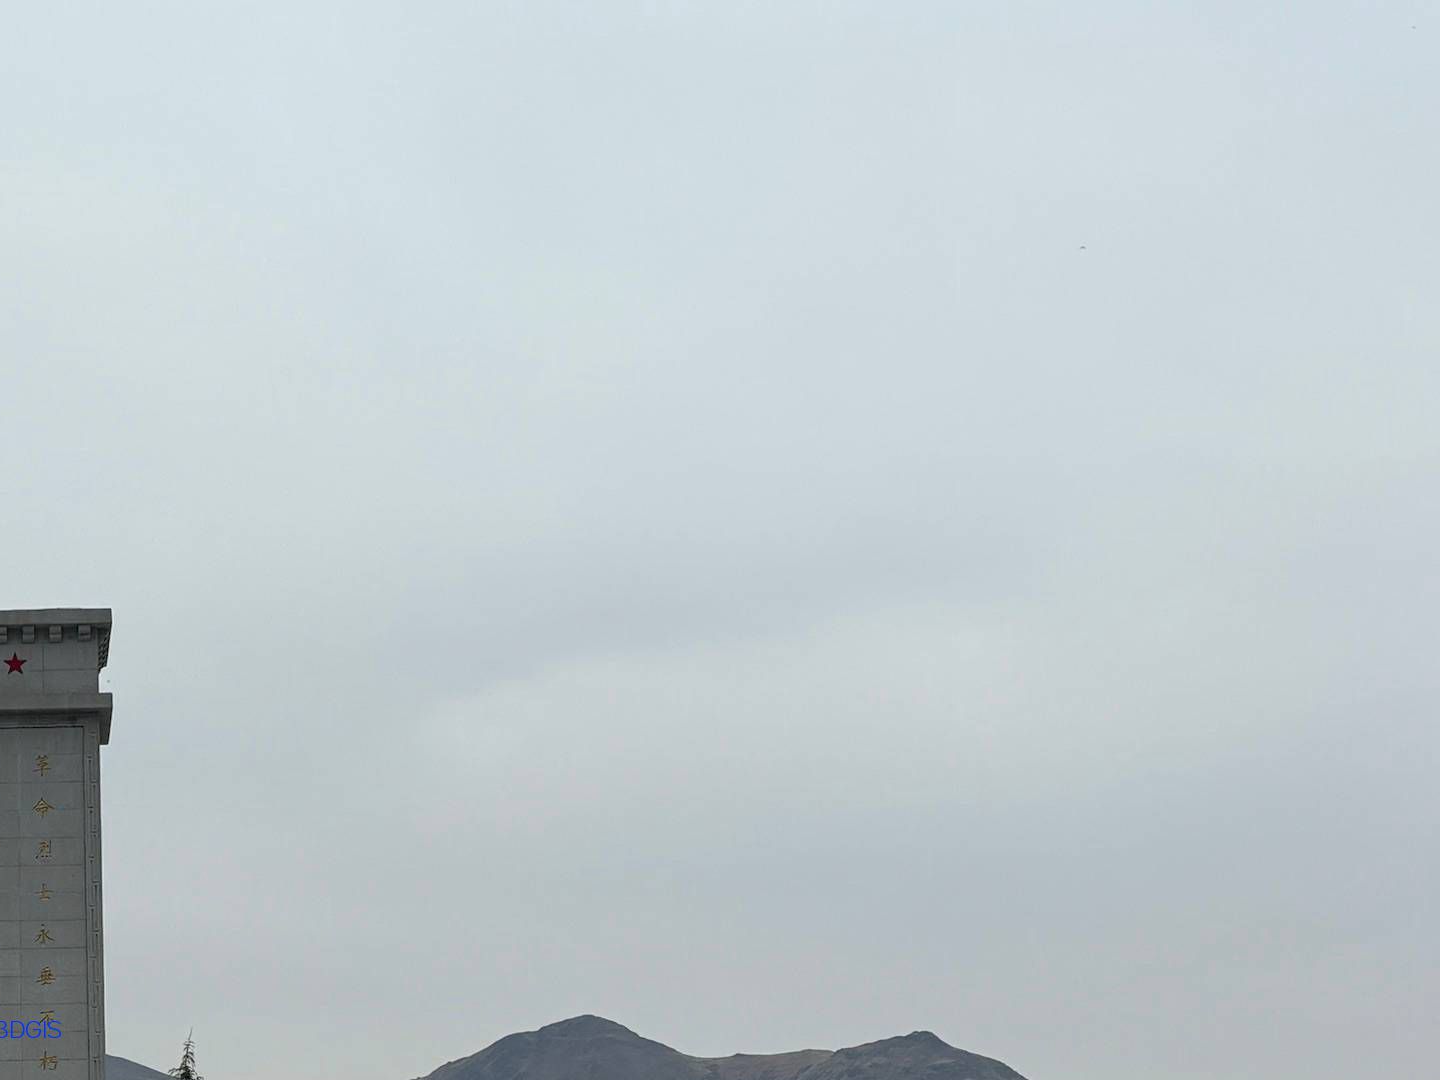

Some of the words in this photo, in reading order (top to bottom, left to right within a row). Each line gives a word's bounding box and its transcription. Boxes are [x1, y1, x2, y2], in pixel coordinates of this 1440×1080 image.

[31, 754, 58, 1071] 革命烈士永垂不朽
